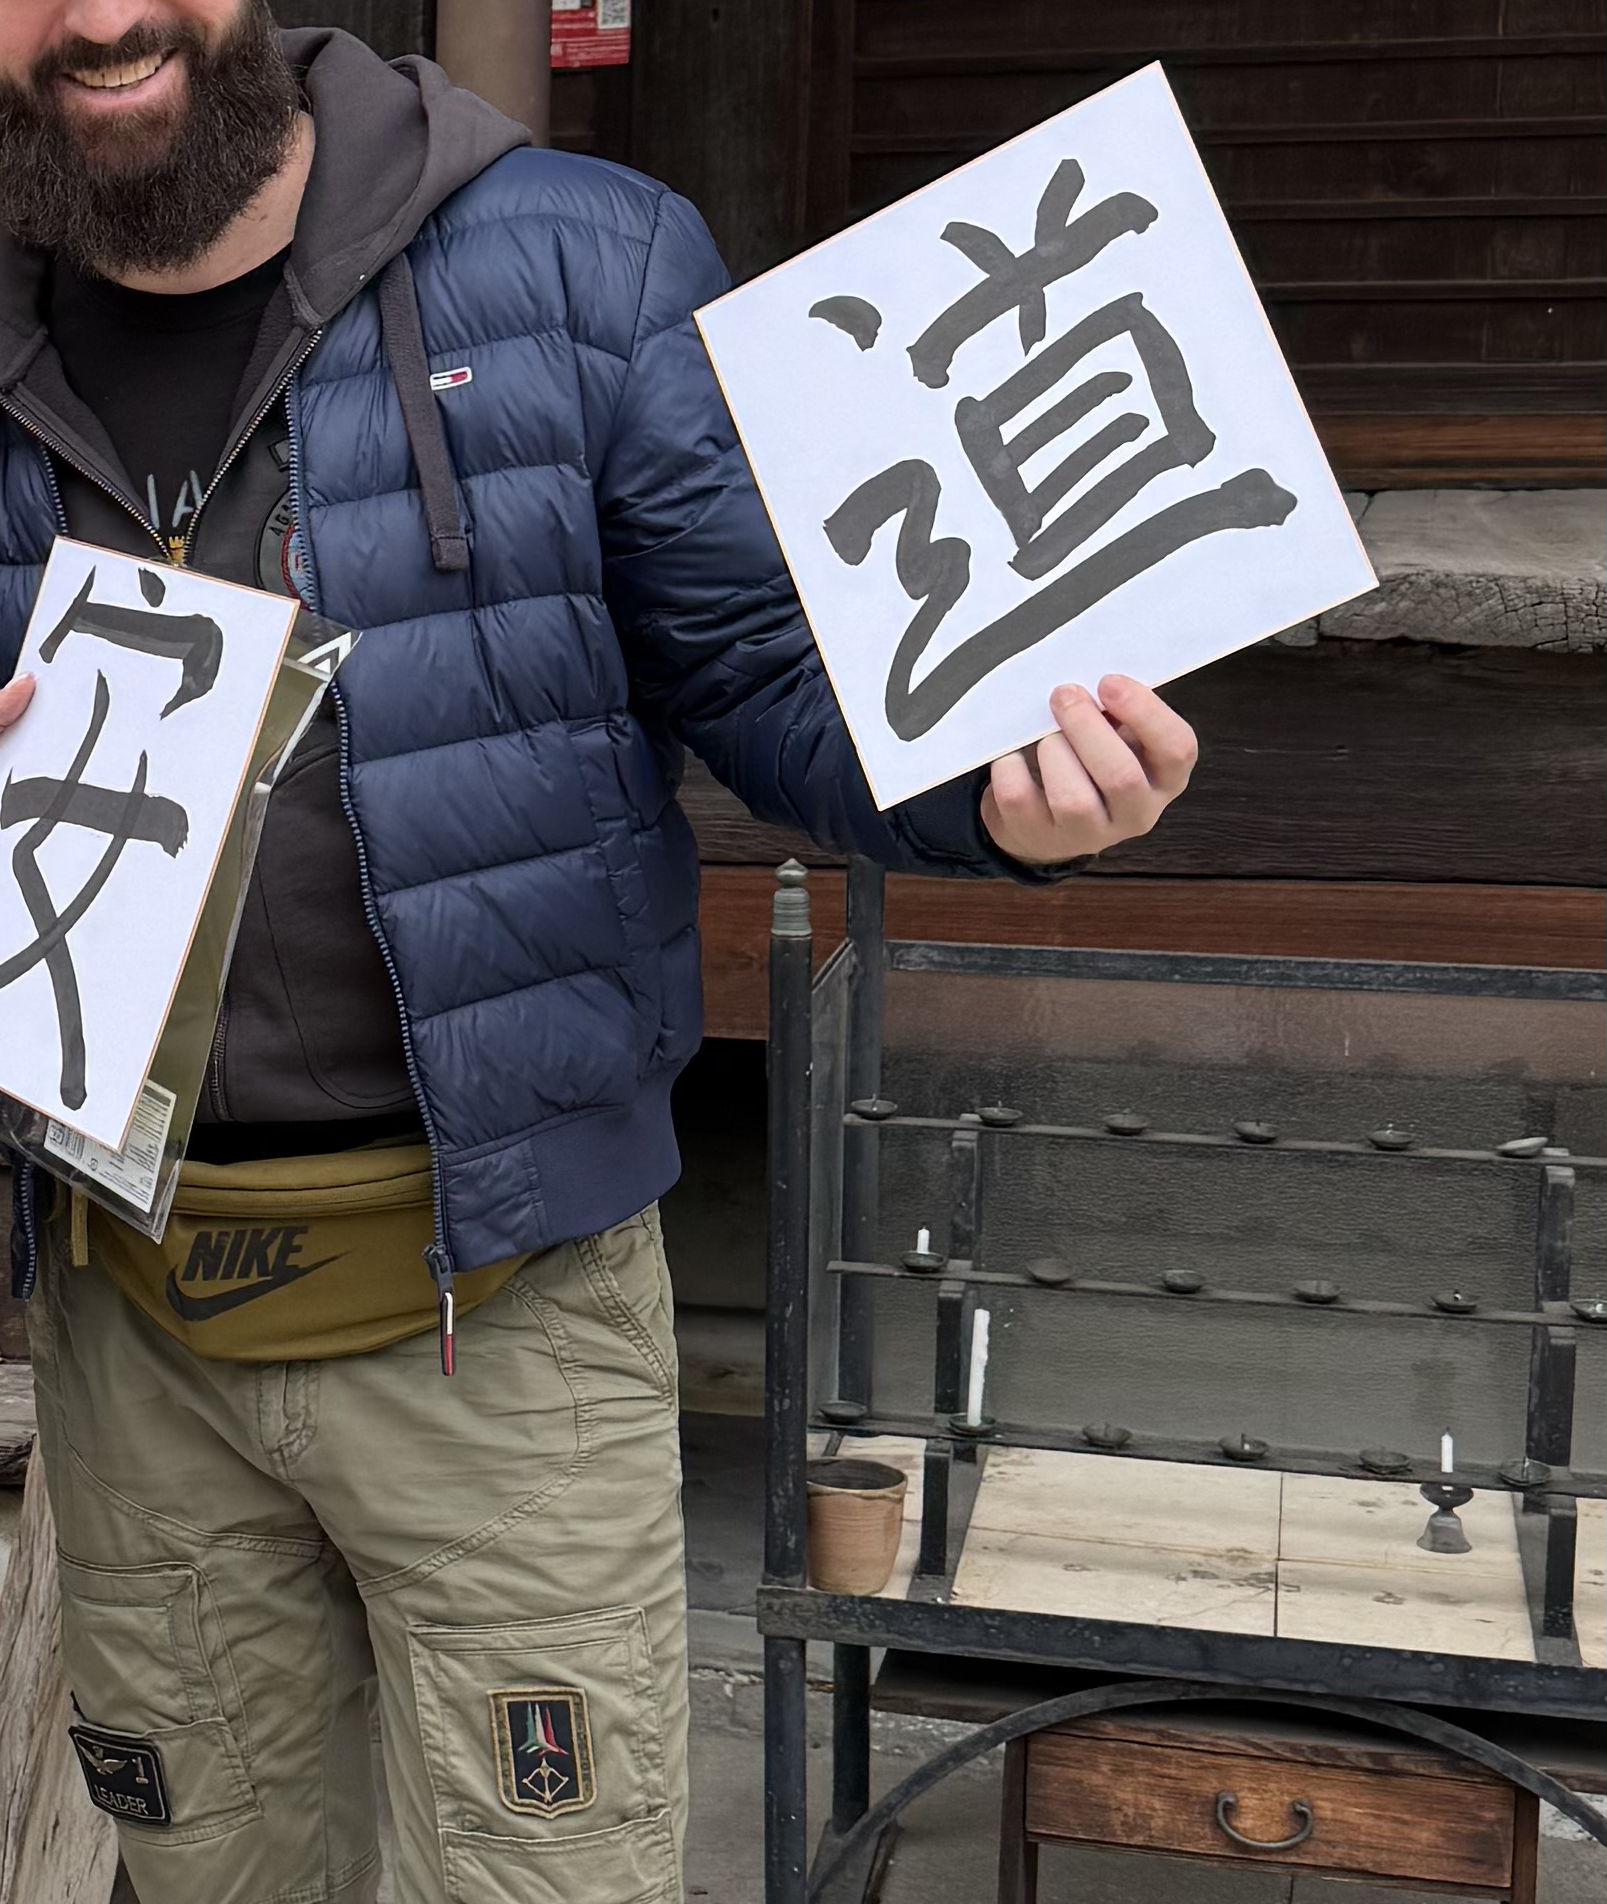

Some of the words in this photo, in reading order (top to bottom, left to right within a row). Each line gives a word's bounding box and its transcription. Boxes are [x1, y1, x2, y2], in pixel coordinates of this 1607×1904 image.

[807, 158, 1299, 743] 道
[181, 1225, 314, 1282] NIKE
[94, 1783, 149, 1816] LEADER
